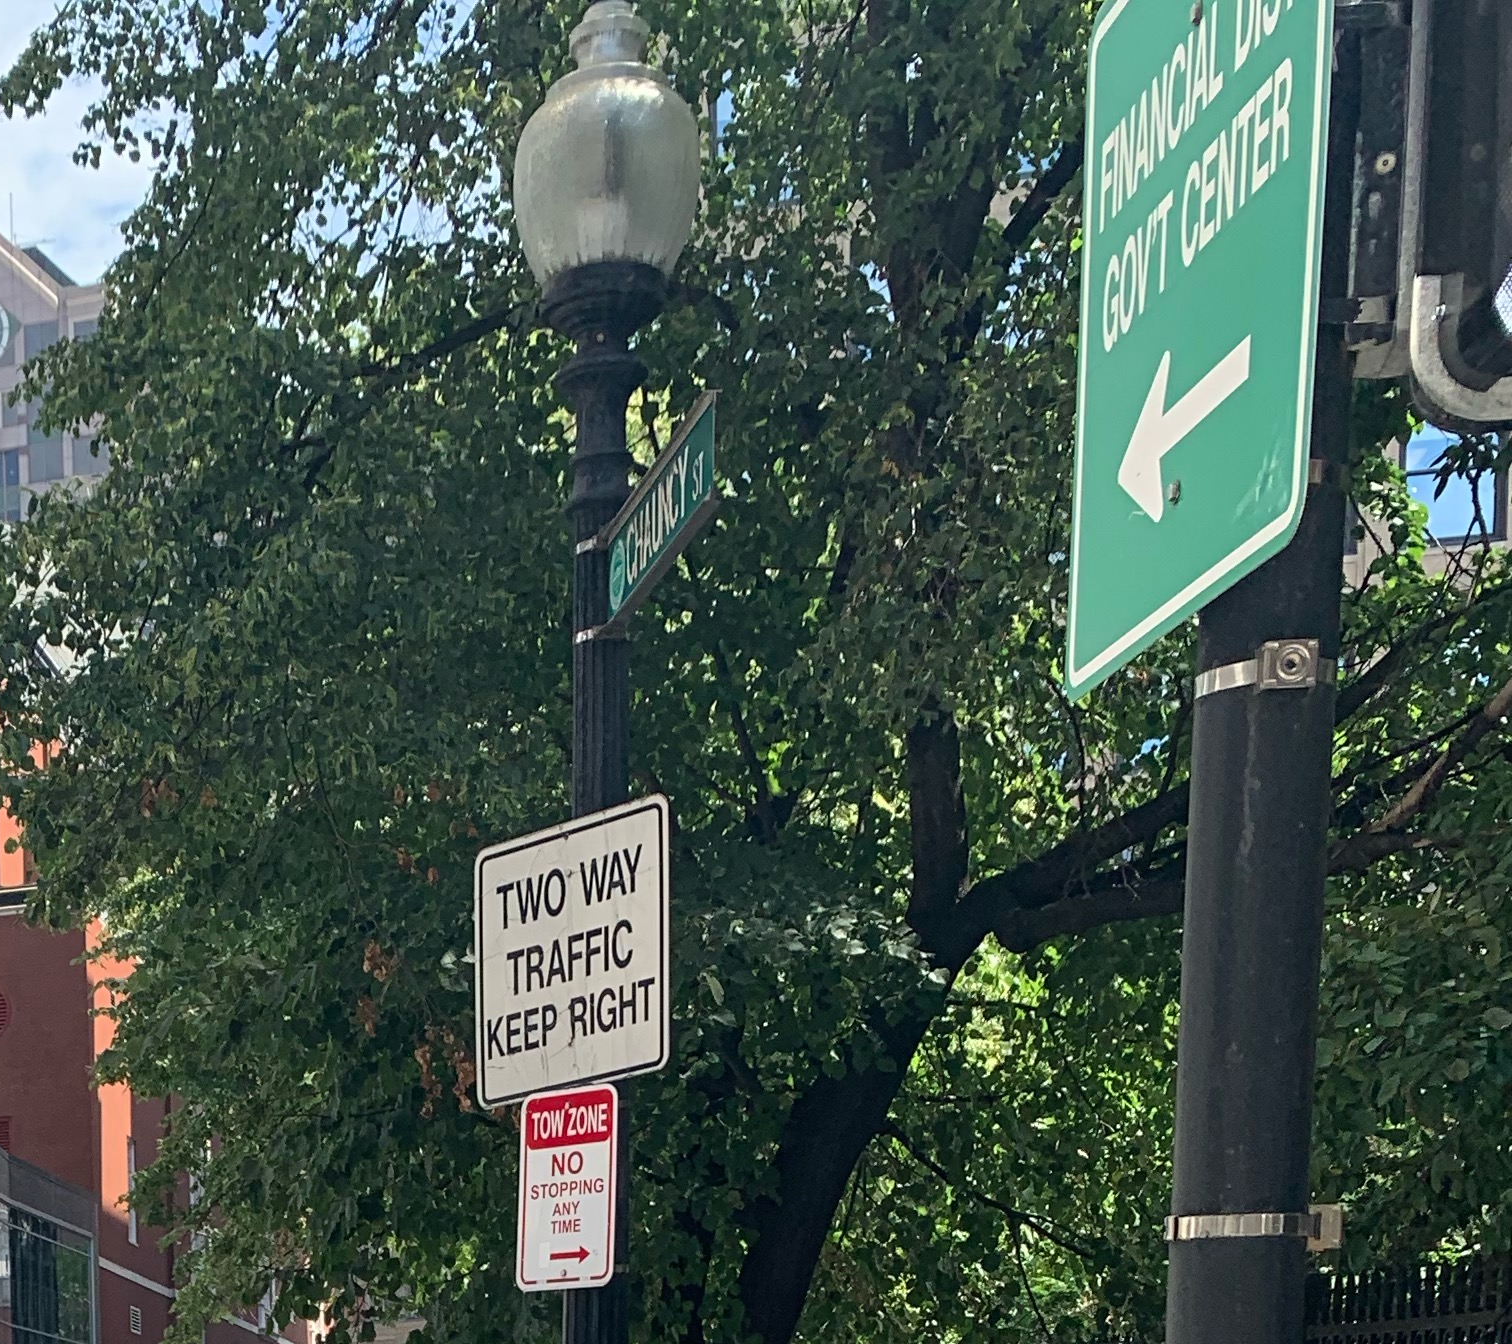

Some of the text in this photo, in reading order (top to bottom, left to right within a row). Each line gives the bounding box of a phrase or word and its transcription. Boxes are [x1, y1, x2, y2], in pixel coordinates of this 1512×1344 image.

[1099, 0, 1223, 233] FINANCIAL
[1102, 57, 1293, 352] GOV'T CENTER
[626, 445, 704, 585] CHAUNCY ST
[496, 844, 642, 929] TWO WAY
[507, 919, 633, 995] TRAFFIC
[487, 977, 655, 1060] KEEP RIGHT
[531, 1103, 609, 1141] TOW ZONE
[530, 1178, 604, 1200] STOPPING
[551, 1151, 584, 1176] NO
[551, 1219, 582, 1234] TIME
[552, 1201, 580, 1216] ANY
